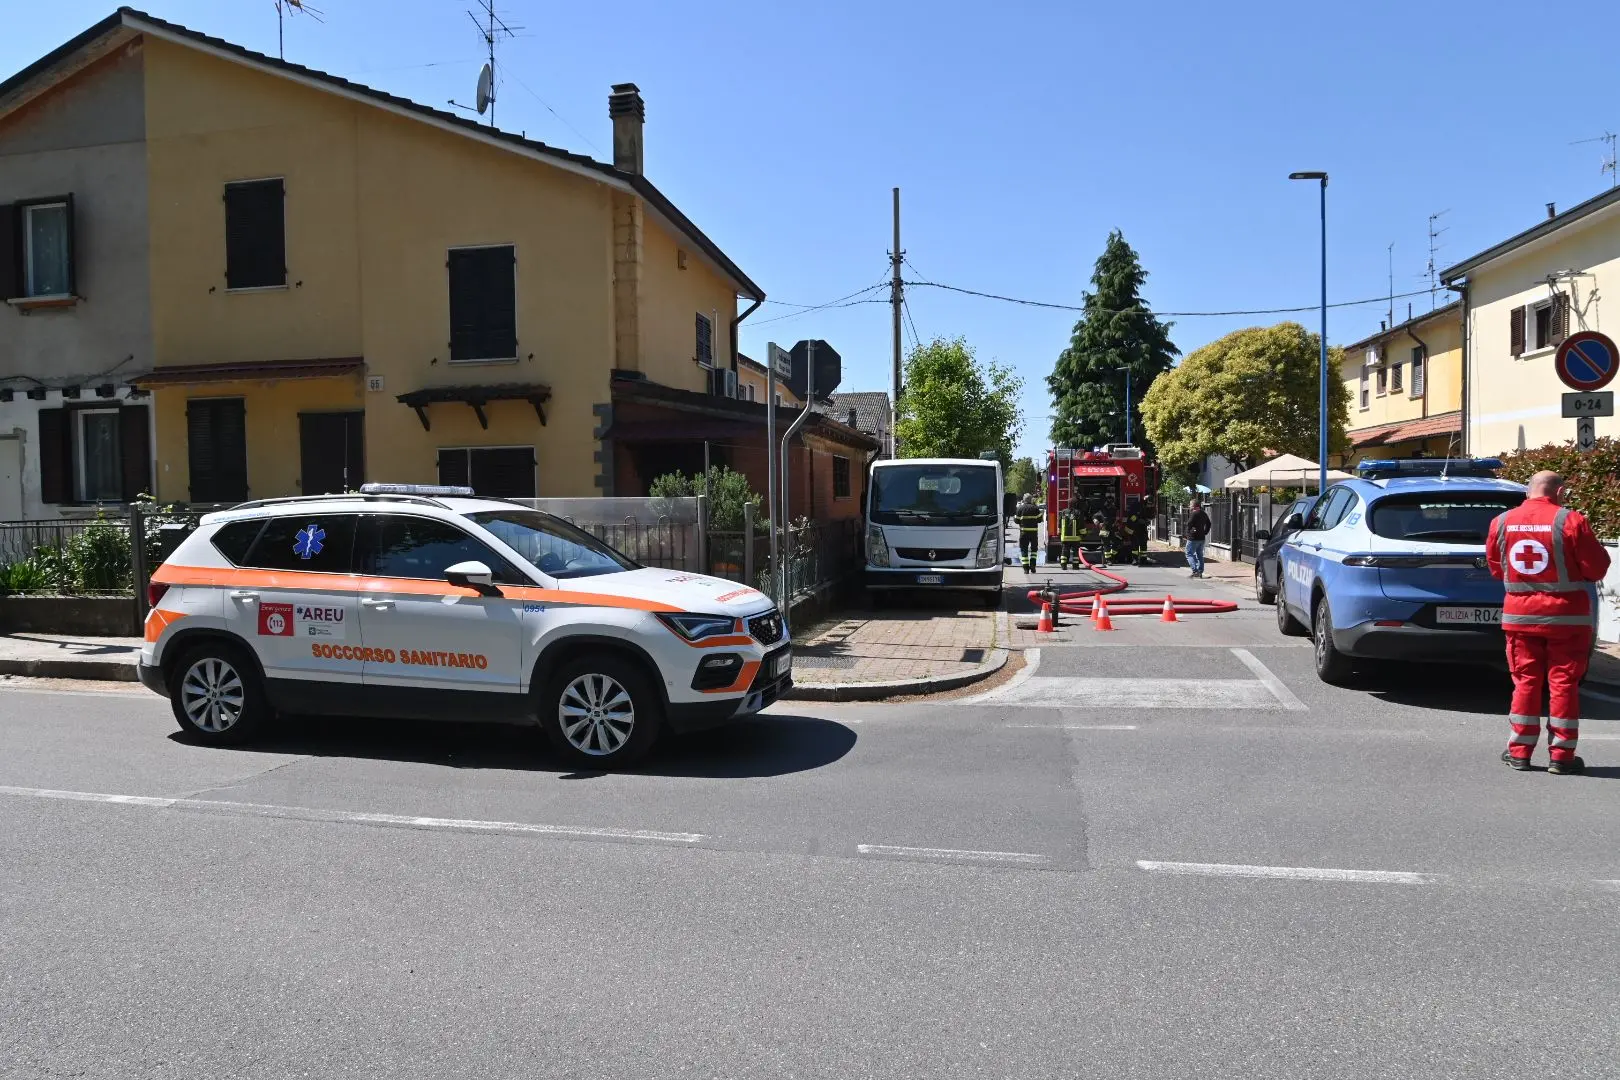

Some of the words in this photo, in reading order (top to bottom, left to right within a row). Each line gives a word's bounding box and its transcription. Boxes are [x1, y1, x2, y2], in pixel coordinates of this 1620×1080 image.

[1574, 399, 1602, 410] 0-24
[524, 604, 545, 613] 0954
[302, 607, 344, 622] AREU
[1439, 610, 1469, 620] POLIZIA
[273, 619, 284, 628] 112
[311, 643, 396, 664] SOCCORSO
[400, 649, 488, 670] SANITARIO
